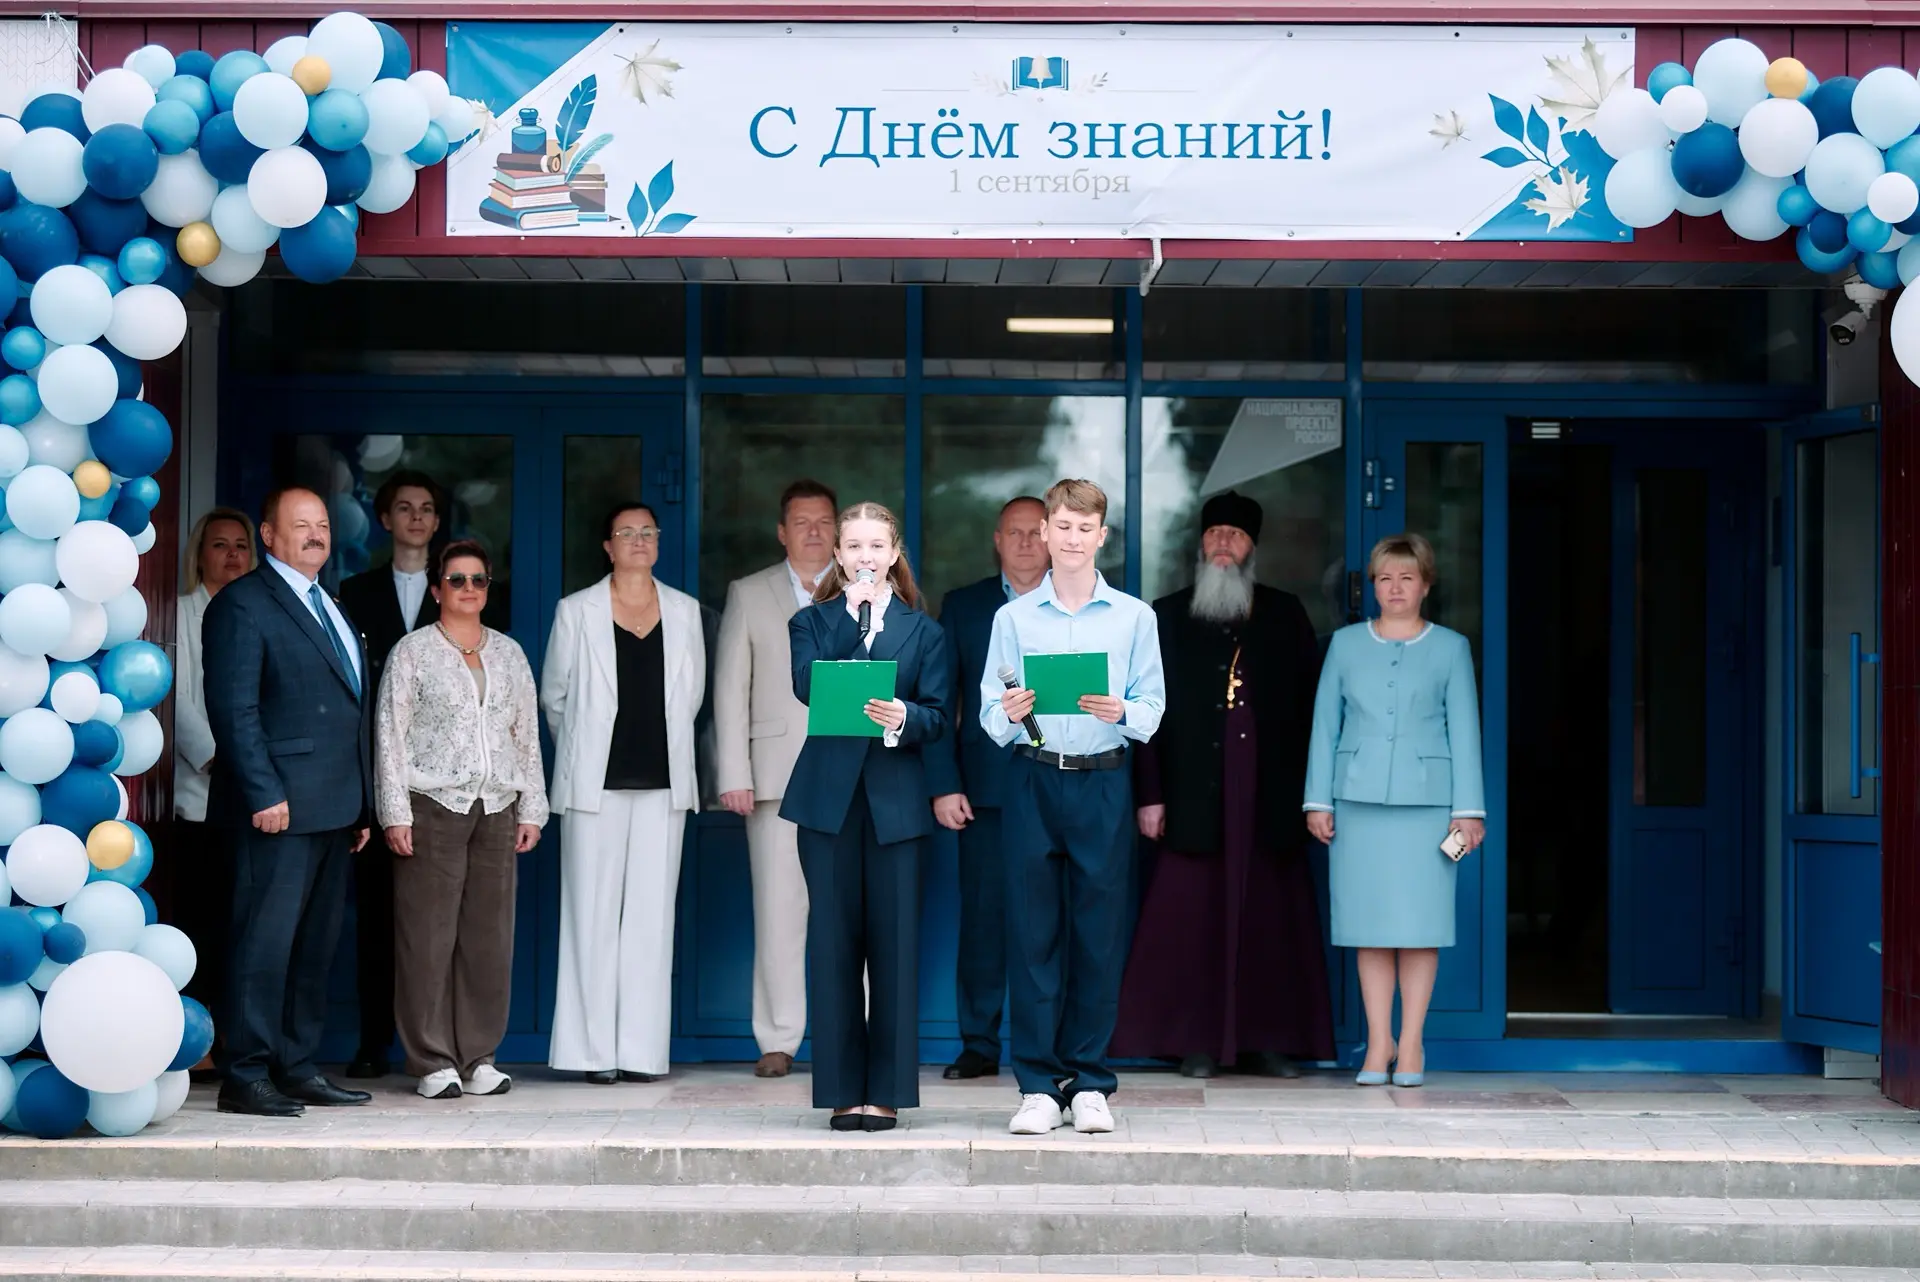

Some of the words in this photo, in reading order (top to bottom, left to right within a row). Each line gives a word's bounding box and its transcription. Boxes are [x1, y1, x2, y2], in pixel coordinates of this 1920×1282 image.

[749, 106, 798, 159] С
[819, 106, 1020, 168] Днём
[1047, 108, 1332, 161] знаний!
[949, 168, 962, 193] 1
[976, 168, 1131, 200] сентября
